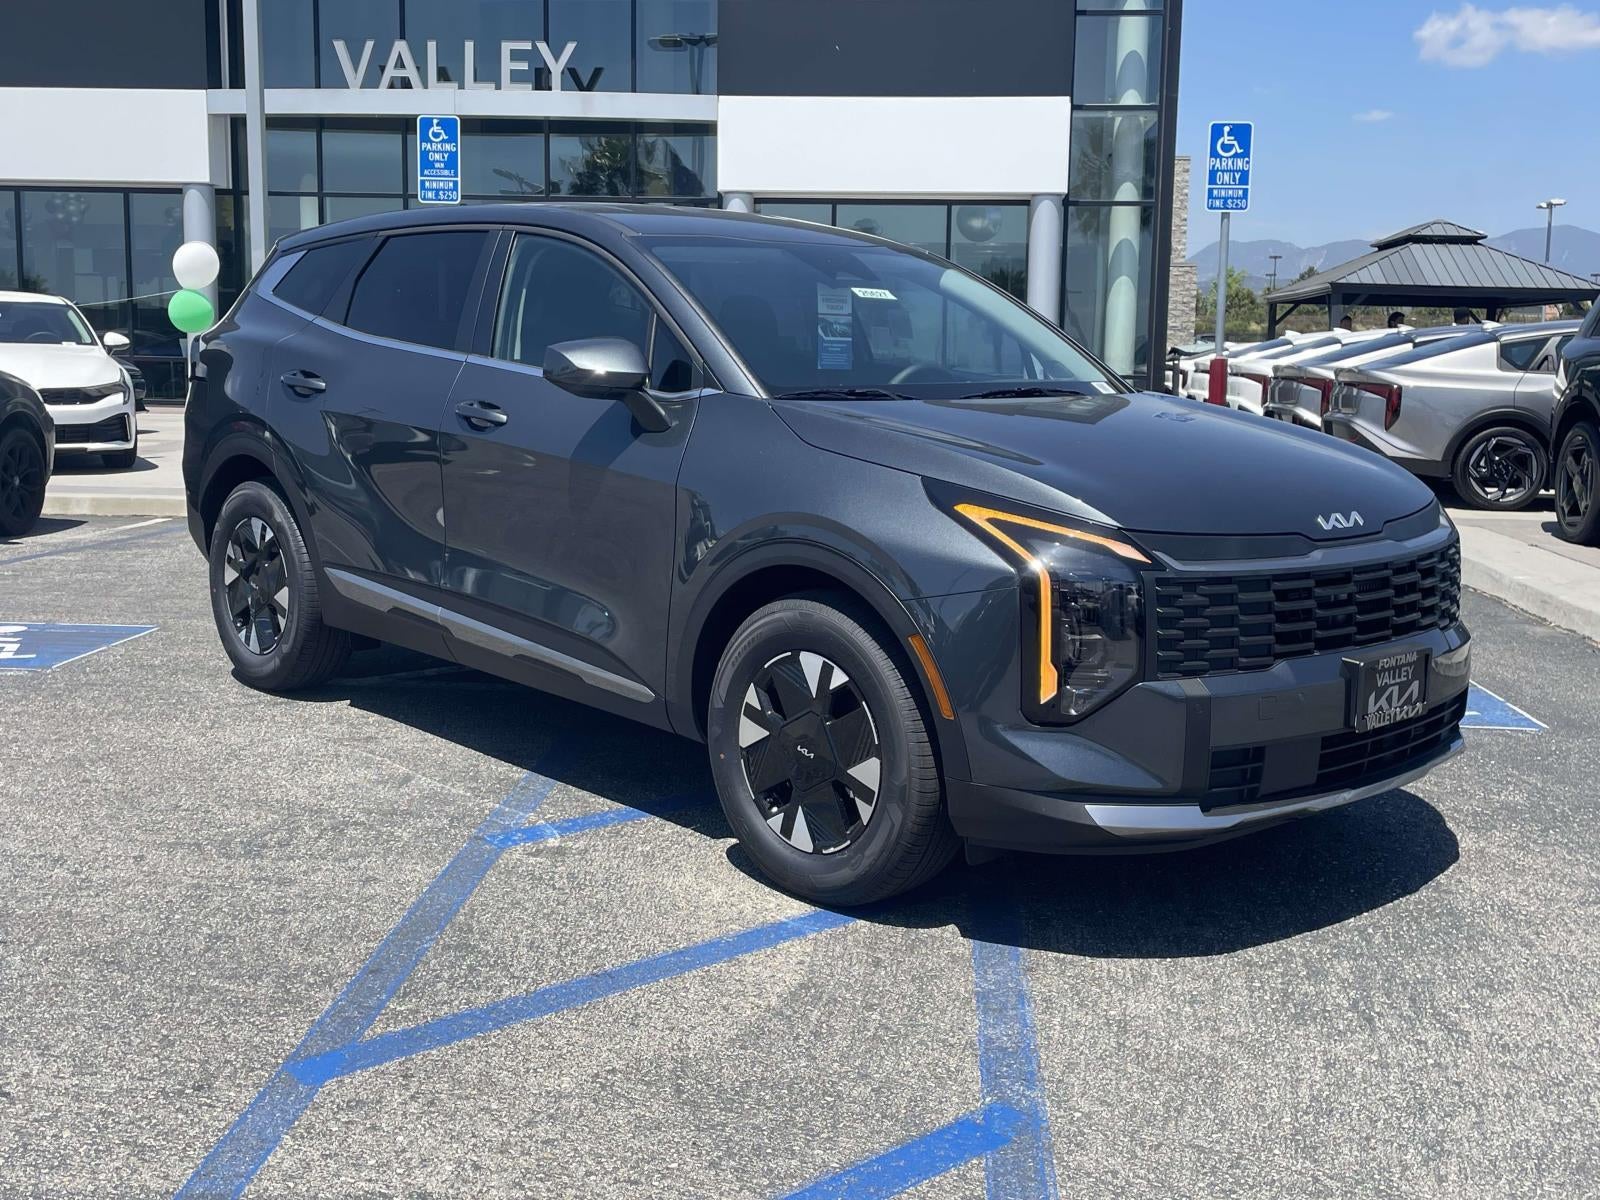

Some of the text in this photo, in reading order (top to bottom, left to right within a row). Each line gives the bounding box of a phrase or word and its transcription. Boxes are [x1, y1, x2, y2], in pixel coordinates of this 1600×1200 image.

[332, 39, 578, 92] VALLEY
[421, 142, 457, 152] PARKING
[428, 152, 449, 162] ONLY
[1209, 157, 1250, 171] PARKING
[1216, 172, 1241, 185] ONLY
[425, 181, 454, 190] MINIMUM
[421, 190, 458, 200] FINE $250
[1212, 189, 1244, 198] MINIMUM
[1208, 198, 1247, 209] FINE $250
[1317, 510, 1365, 530] KIA
[1378, 651, 1418, 670] FONTANA
[1376, 665, 1415, 687] VALLEY
[1367, 680, 1419, 714] KIA
[1364, 709, 1396, 731] VALLEY
